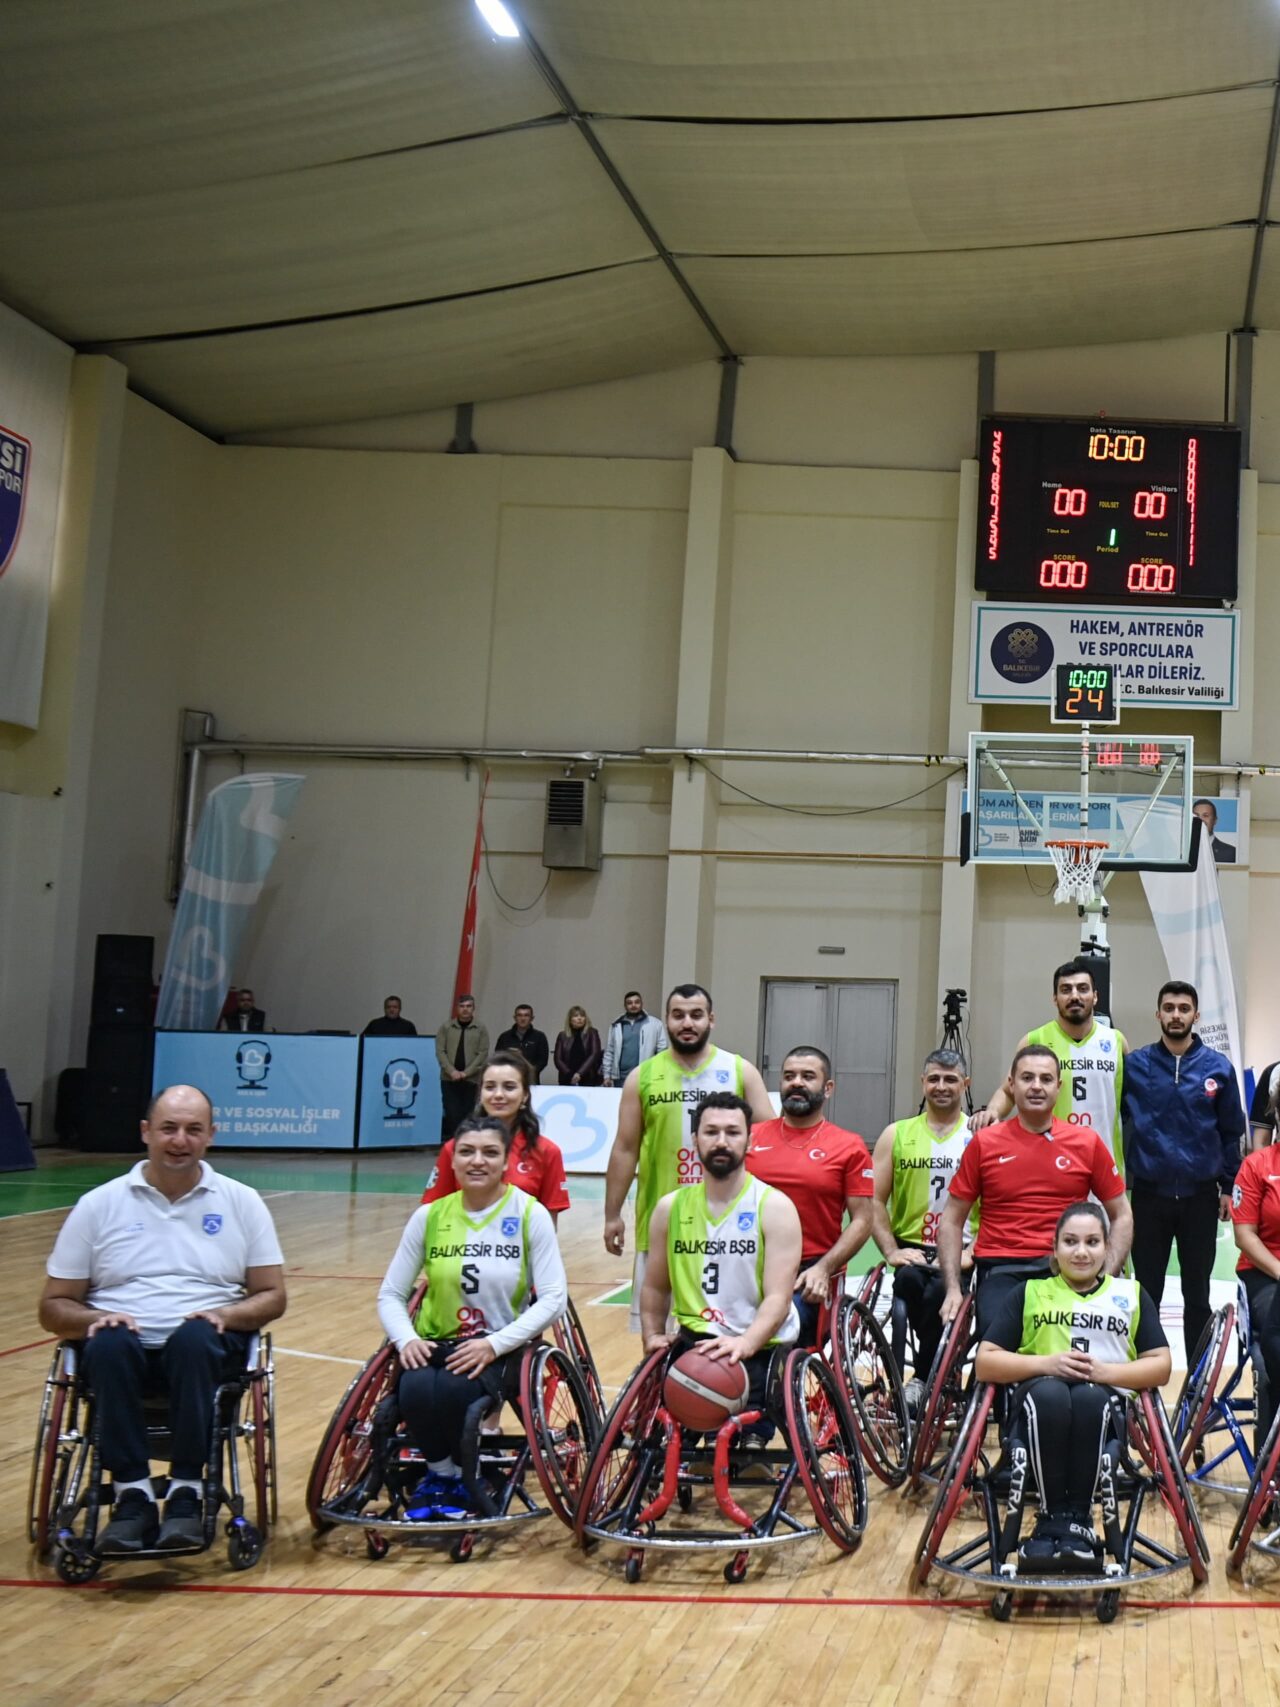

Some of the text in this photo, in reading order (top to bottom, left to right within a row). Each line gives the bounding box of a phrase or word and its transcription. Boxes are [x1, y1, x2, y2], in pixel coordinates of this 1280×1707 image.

[1088, 434, 1145, 461] 10:00
[1151, 485, 1178, 493] Visitors
[1054, 488, 1086, 515] 00
[1134, 491, 1166, 518] 00
[1040, 560, 1088, 588] 000
[1127, 563, 1175, 591] 000
[1070, 620, 1204, 638] HAKEM, ANTRENÖR
[1079, 641, 1194, 659] VE SPORCULARA
[1069, 670, 1107, 688] 10:00
[1148, 661, 1205, 681] DİLERİZ.
[1065, 687, 1104, 713] 24
[1138, 685, 1185, 696] Balıkesir
[1188, 686, 1224, 699] Valiliği
[1060, 1057, 1115, 1072] IKESİR BŞB
[1072, 1076, 1087, 1101] 6
[224, 1107, 242, 1118] VE
[246, 1107, 298, 1118] SOSYAL
[302, 1105, 341, 1124] İŞLER
[234, 1120, 317, 1136] BAŞKANLIĞI
[900, 1155, 953, 1170] BALIKESİR
[930, 1175, 945, 1200] 7
[429, 1241, 520, 1260] BALIKESİR BŞB
[674, 1237, 756, 1257] BALIKESİR BŞB
[702, 1262, 719, 1295] 3
[1033, 1310, 1103, 1330] BALIKESİR
[1007, 1447, 1027, 1515] EXTRA
[1100, 1453, 1116, 1524] EXTRA
